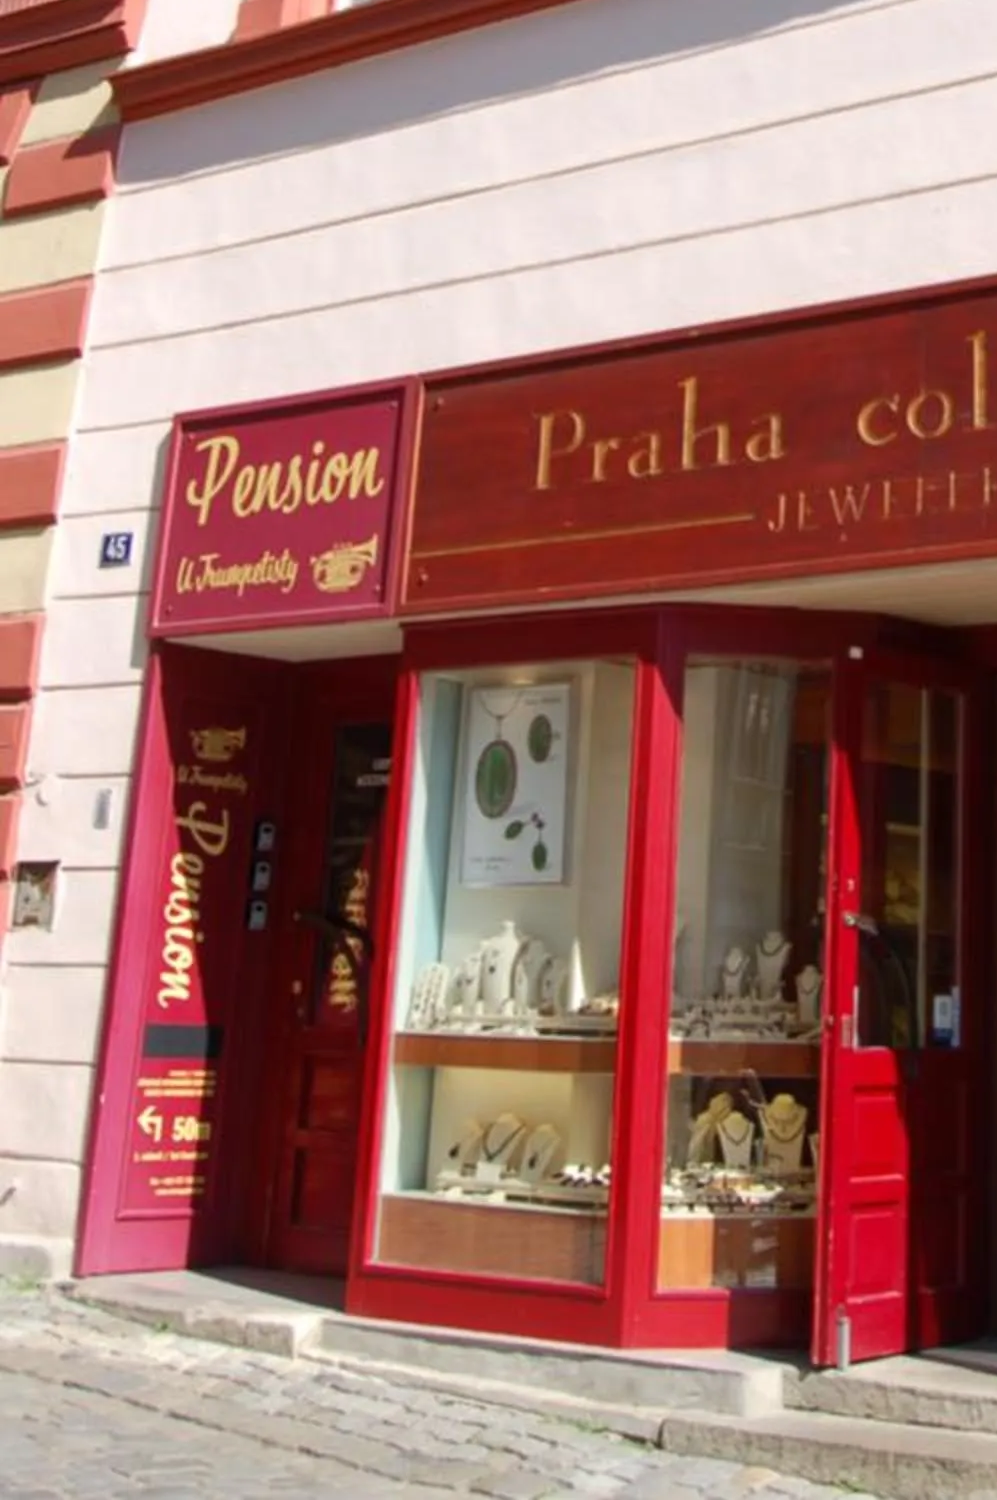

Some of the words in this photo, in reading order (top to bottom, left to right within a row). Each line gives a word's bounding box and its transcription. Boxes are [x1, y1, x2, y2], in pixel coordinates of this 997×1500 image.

[187, 435, 384, 526] Pension
[531, 376, 785, 490] Praha
[106, 535, 128, 559] 45
[157, 799, 230, 1011] Pension
